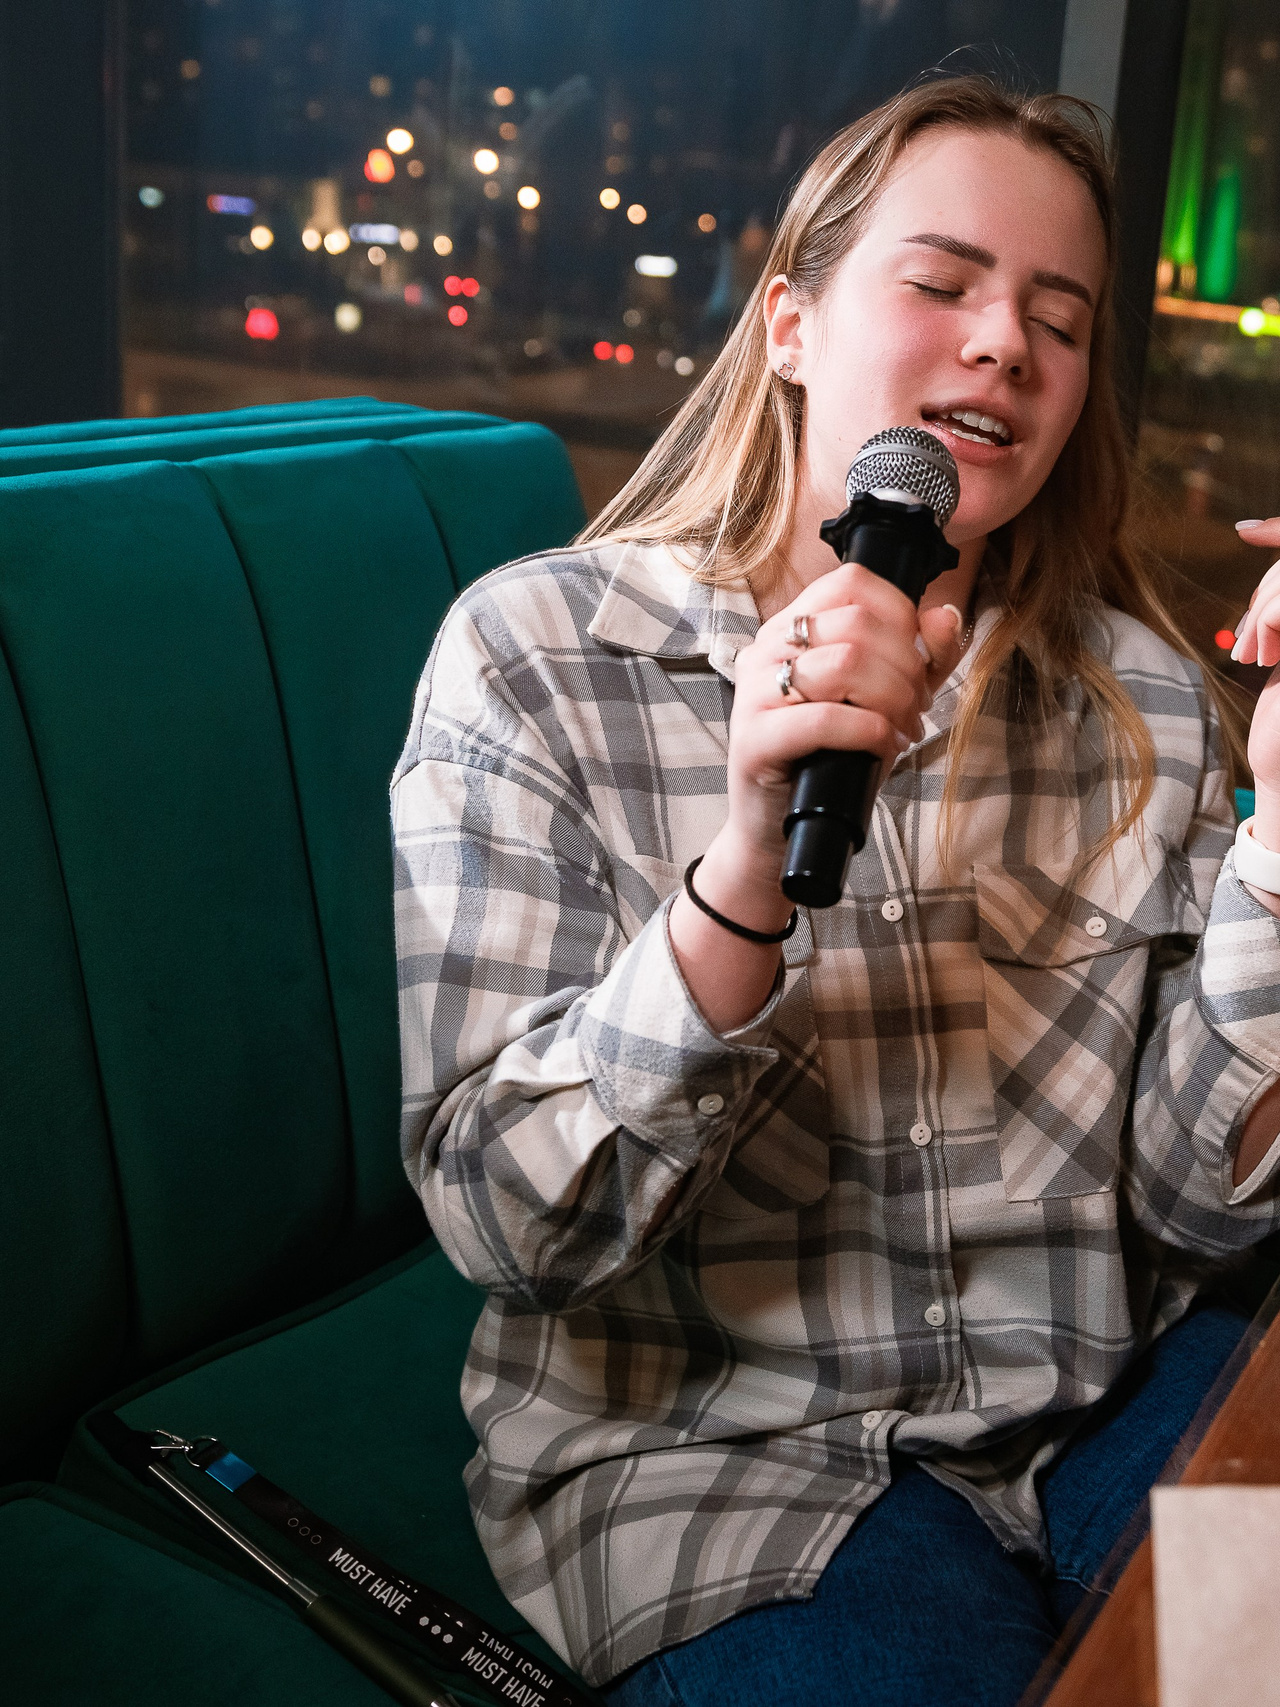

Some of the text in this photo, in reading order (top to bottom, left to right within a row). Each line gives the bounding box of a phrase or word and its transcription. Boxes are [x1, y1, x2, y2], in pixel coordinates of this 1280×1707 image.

[328, 1547, 412, 1616] MUST HAVE
[460, 1646, 546, 1707] MUST HAVE
